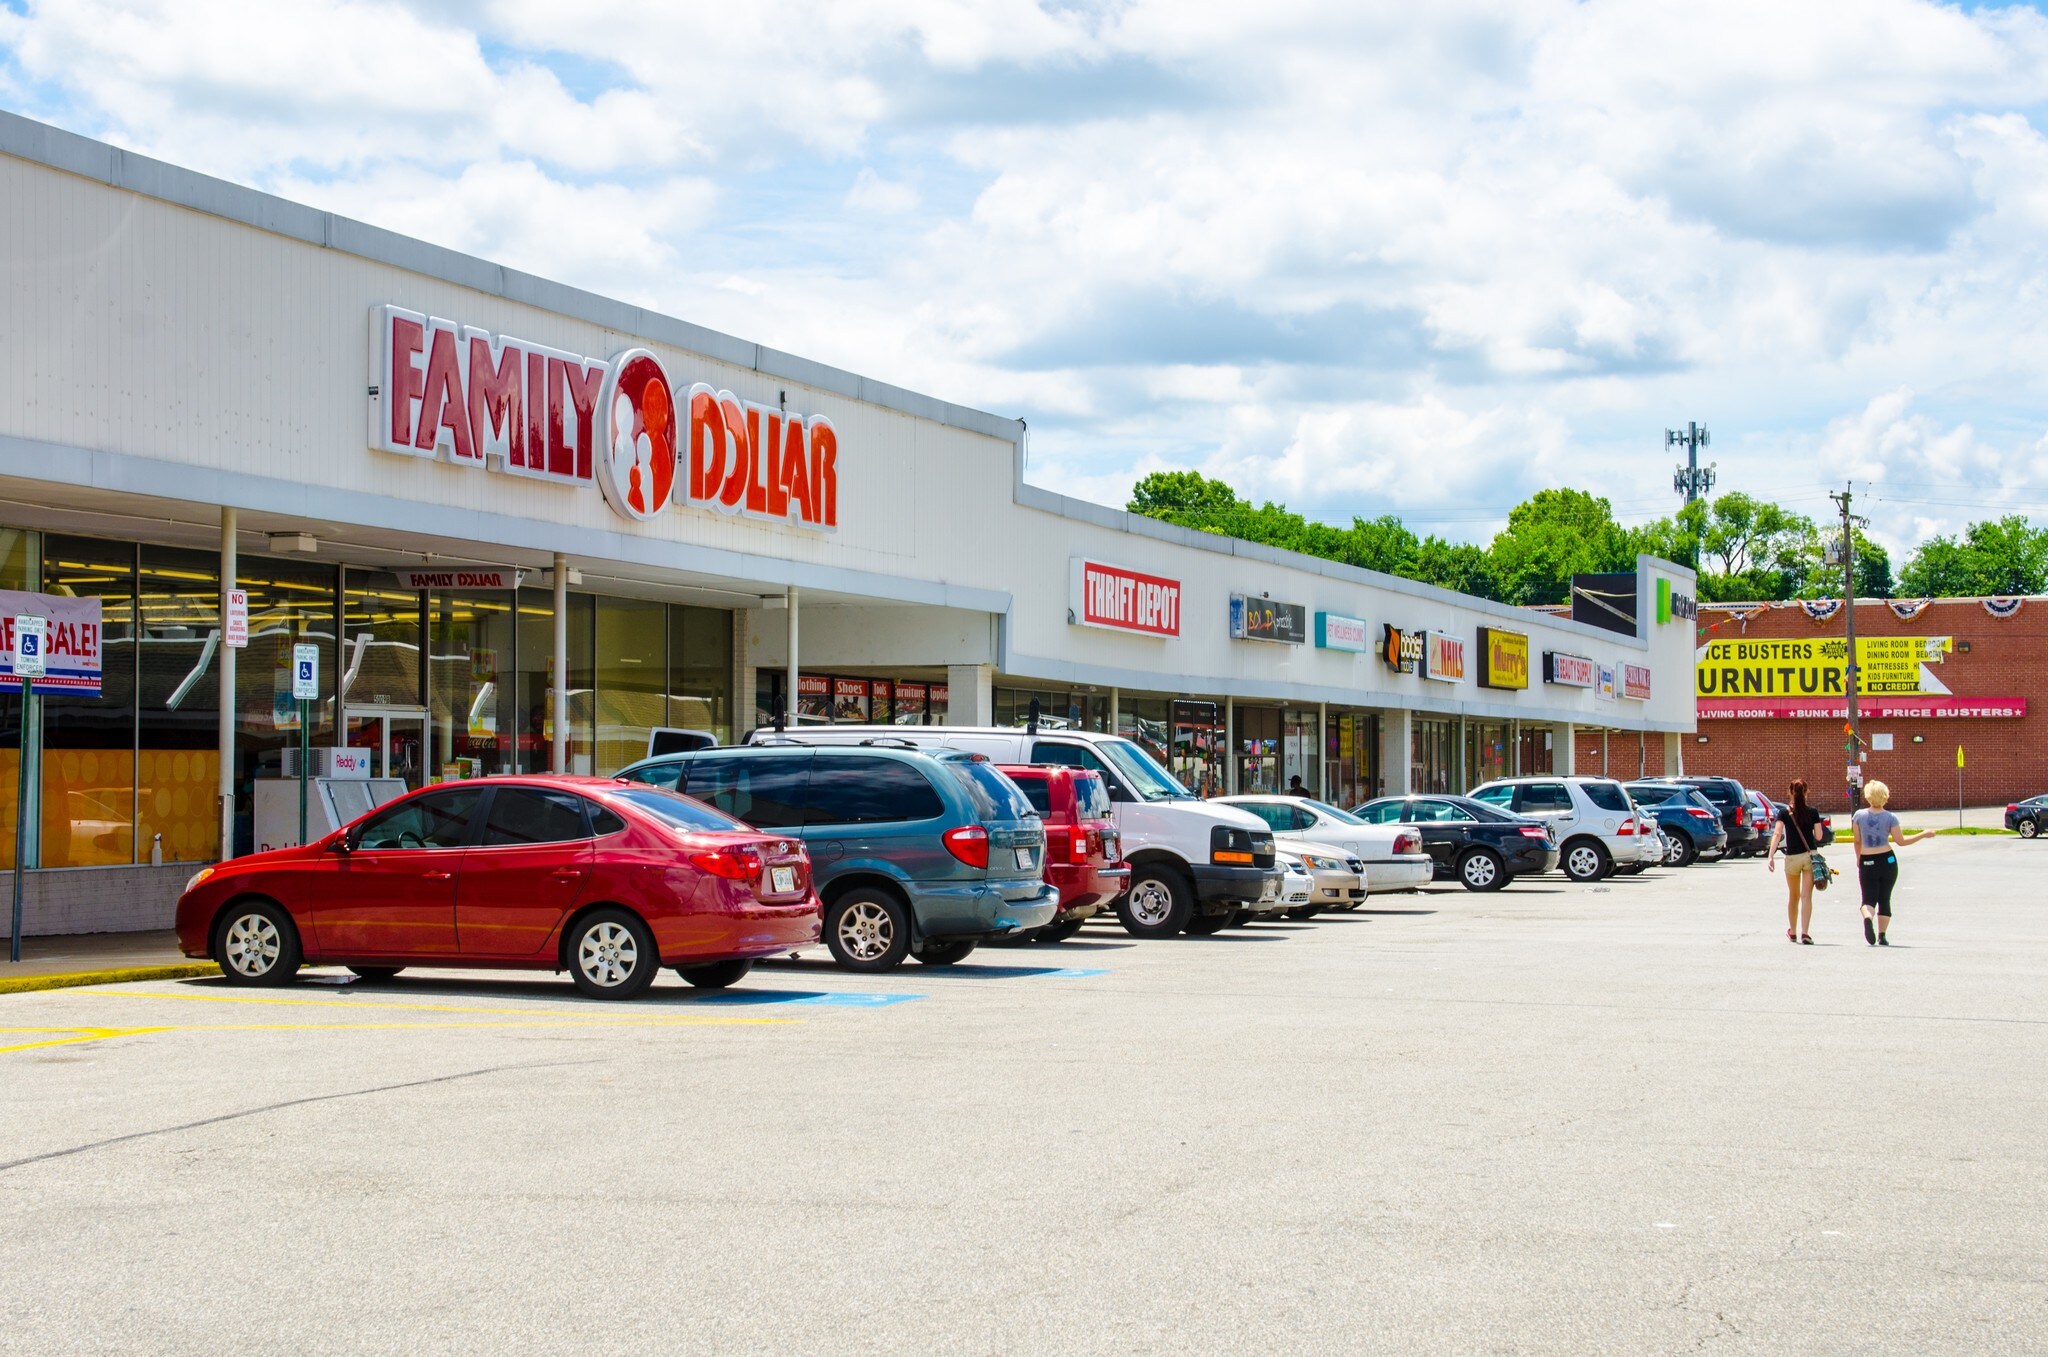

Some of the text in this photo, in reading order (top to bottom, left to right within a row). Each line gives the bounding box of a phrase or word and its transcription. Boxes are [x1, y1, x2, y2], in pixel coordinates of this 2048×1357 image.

[391, 315, 837, 527] FAMILY DOLLAR
[410, 572, 503, 587] FAMILY DOLLAR
[231, 594, 244, 605] NO
[1087, 570, 1178, 630] THRIFT DEPOT
[46, 620, 97, 657] SALE!
[1400, 631, 1424, 660] boost
[1867, 640, 1946, 648] LIVING ROOM BEDROOM
[1706, 643, 1813, 660] ICE BUSTERS
[1867, 650, 1890, 658] DINING
[1891, 650, 1910, 658] ROOM
[21, 656, 39, 664] TOWING
[1441, 639, 1463, 679] NAILS
[1494, 643, 1526, 680] Murry's
[1868, 662, 1909, 670] MATTRESSES
[17, 663, 43, 671] ENFORCED
[1560, 657, 1577, 681] BEAUTY
[1577, 660, 1593, 684] SUPPLY
[1698, 667, 1862, 693] URNITUR
[1867, 672, 1914, 680] KIDS FURNITURE
[798, 678, 826, 693] lothing
[837, 681, 863, 694] Shoes
[873, 683, 887, 695] Tools
[894, 685, 926, 698] urniture
[1871, 683, 1883, 691] NO
[1885, 683, 1915, 691] CREDIT
[1701, 708, 2013, 718] LIVING ROOM BUNK BES PRICE BUSTERS
[336, 754, 357, 771] Reddy
